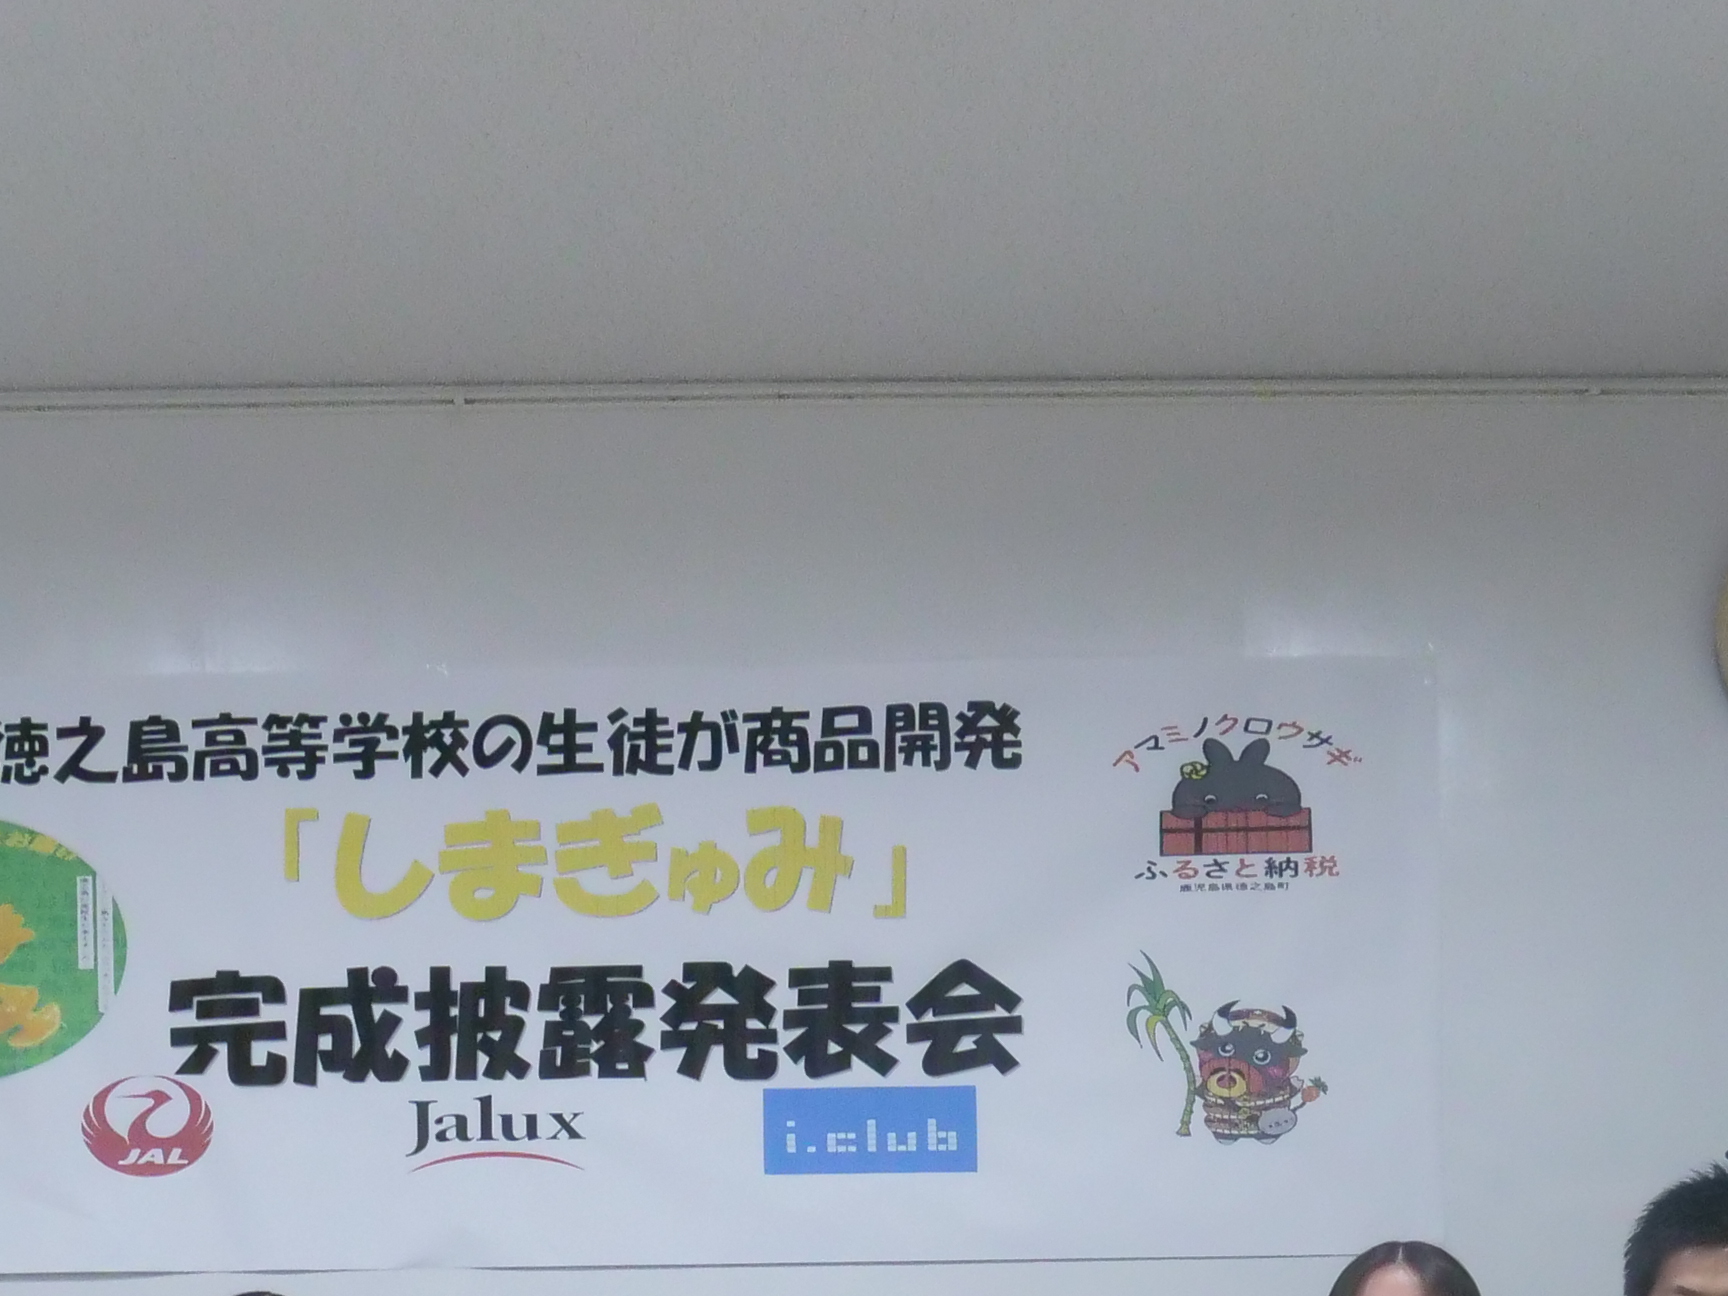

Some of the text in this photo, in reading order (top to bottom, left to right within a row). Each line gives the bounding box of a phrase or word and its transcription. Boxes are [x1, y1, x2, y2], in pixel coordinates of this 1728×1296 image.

[1113, 713, 1362, 773] アマミノクロウサギ
[283, 802, 907, 921] 「しまぎゅみ」
[1134, 854, 1340, 881] ふるさと納税
[1179, 881, 1291, 893] 鹿児島県徳之島町
[168, 958, 1024, 1087] 完成披露発表会
[407, 1096, 586, 1157] Jalux
[784, 1118, 959, 1155] i.club
[118, 1147, 189, 1165] JAL
